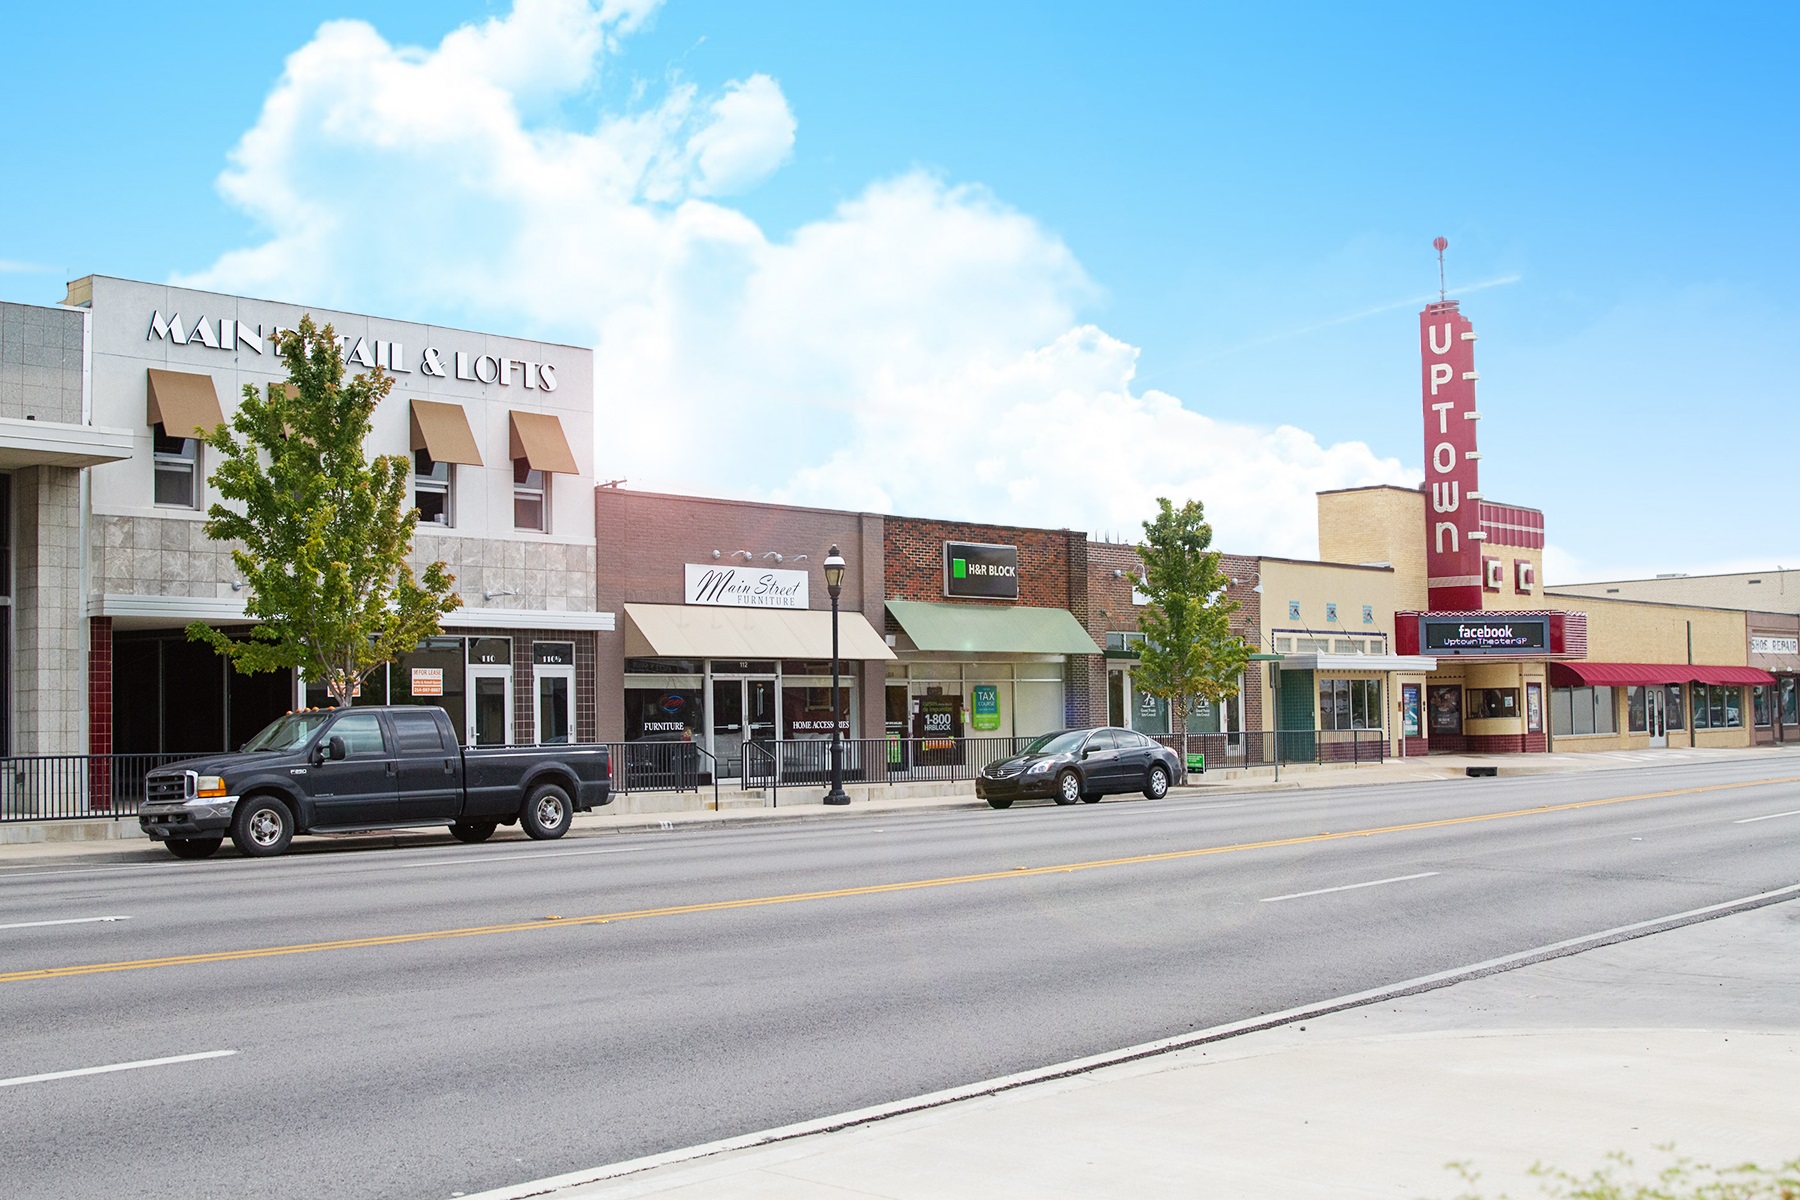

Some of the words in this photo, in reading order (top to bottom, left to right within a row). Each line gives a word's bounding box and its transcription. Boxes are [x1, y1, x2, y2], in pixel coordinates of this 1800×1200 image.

[147, 310, 263, 355] MAIN
[421, 346, 447, 377] &
[456, 351, 558, 392] LOFTS
[1429, 323, 1459, 554] UPTOWN
[968, 564, 987, 576] H&R
[989, 565, 1016, 577] BLOCK
[695, 569, 751, 602] Main
[754, 574, 801, 595] Street
[737, 595, 795, 606] FURNITURE
[1458, 625, 1513, 638] facebook
[1443, 638, 1527, 646] UptownTheaterGP
[1772, 640, 1797, 651] REPAIR
[482, 655, 496, 663] 110
[977, 691, 995, 701] TAX
[793, 720, 812, 729] HOME
[813, 720, 850, 729] ACCESSRIES
[924, 713, 951, 725] 1-800
[644, 721, 685, 732] FURNITURE
